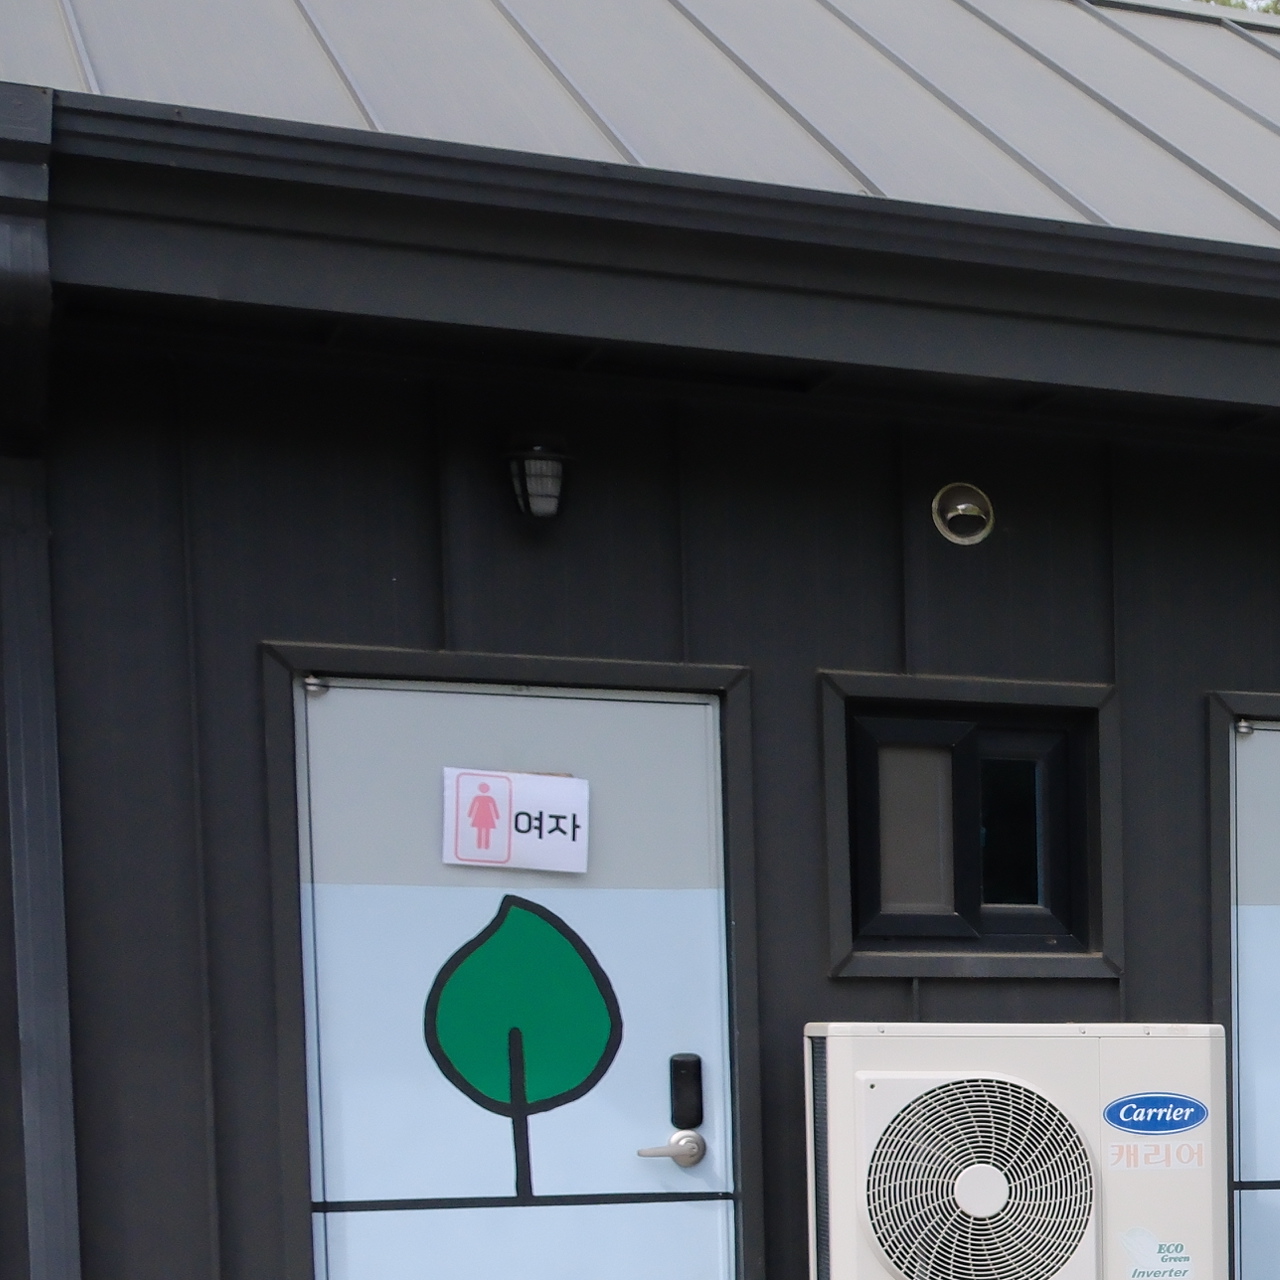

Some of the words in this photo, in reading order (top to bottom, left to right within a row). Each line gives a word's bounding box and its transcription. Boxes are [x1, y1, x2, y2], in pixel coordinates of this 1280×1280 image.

[513, 810, 582, 842] 여자
[1118, 1102, 1195, 1123] Carrier
[1110, 1142, 1204, 1169] 캐리어
[1156, 1242, 1185, 1254] ECO
[1160, 1253, 1191, 1264] Green
[1130, 1266, 1190, 1280] Inverter
